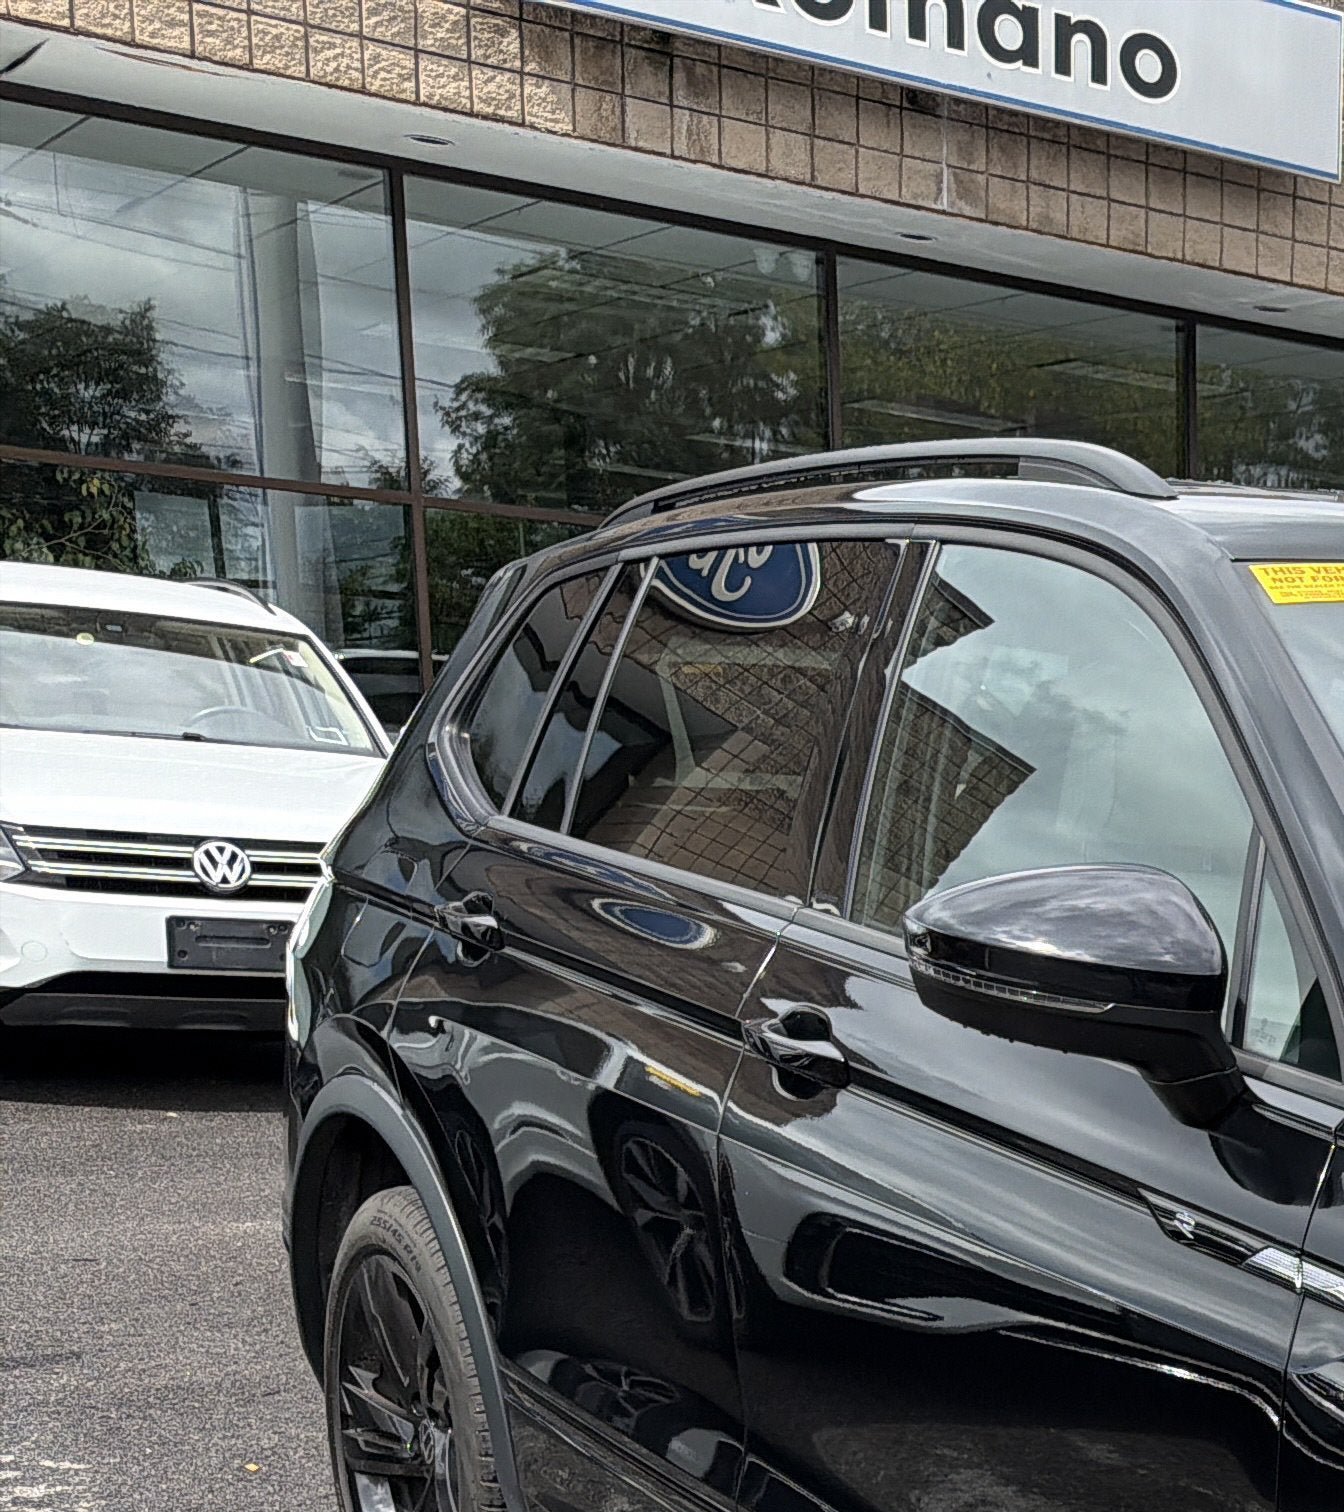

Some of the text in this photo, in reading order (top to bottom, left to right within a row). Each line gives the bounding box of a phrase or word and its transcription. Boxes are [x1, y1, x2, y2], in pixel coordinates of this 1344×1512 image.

[728, 0, 1180, 100] mano
[1260, 566, 1307, 577] THIS
[1271, 575, 1300, 585] NOT
[196, 843, 250, 888] VW
